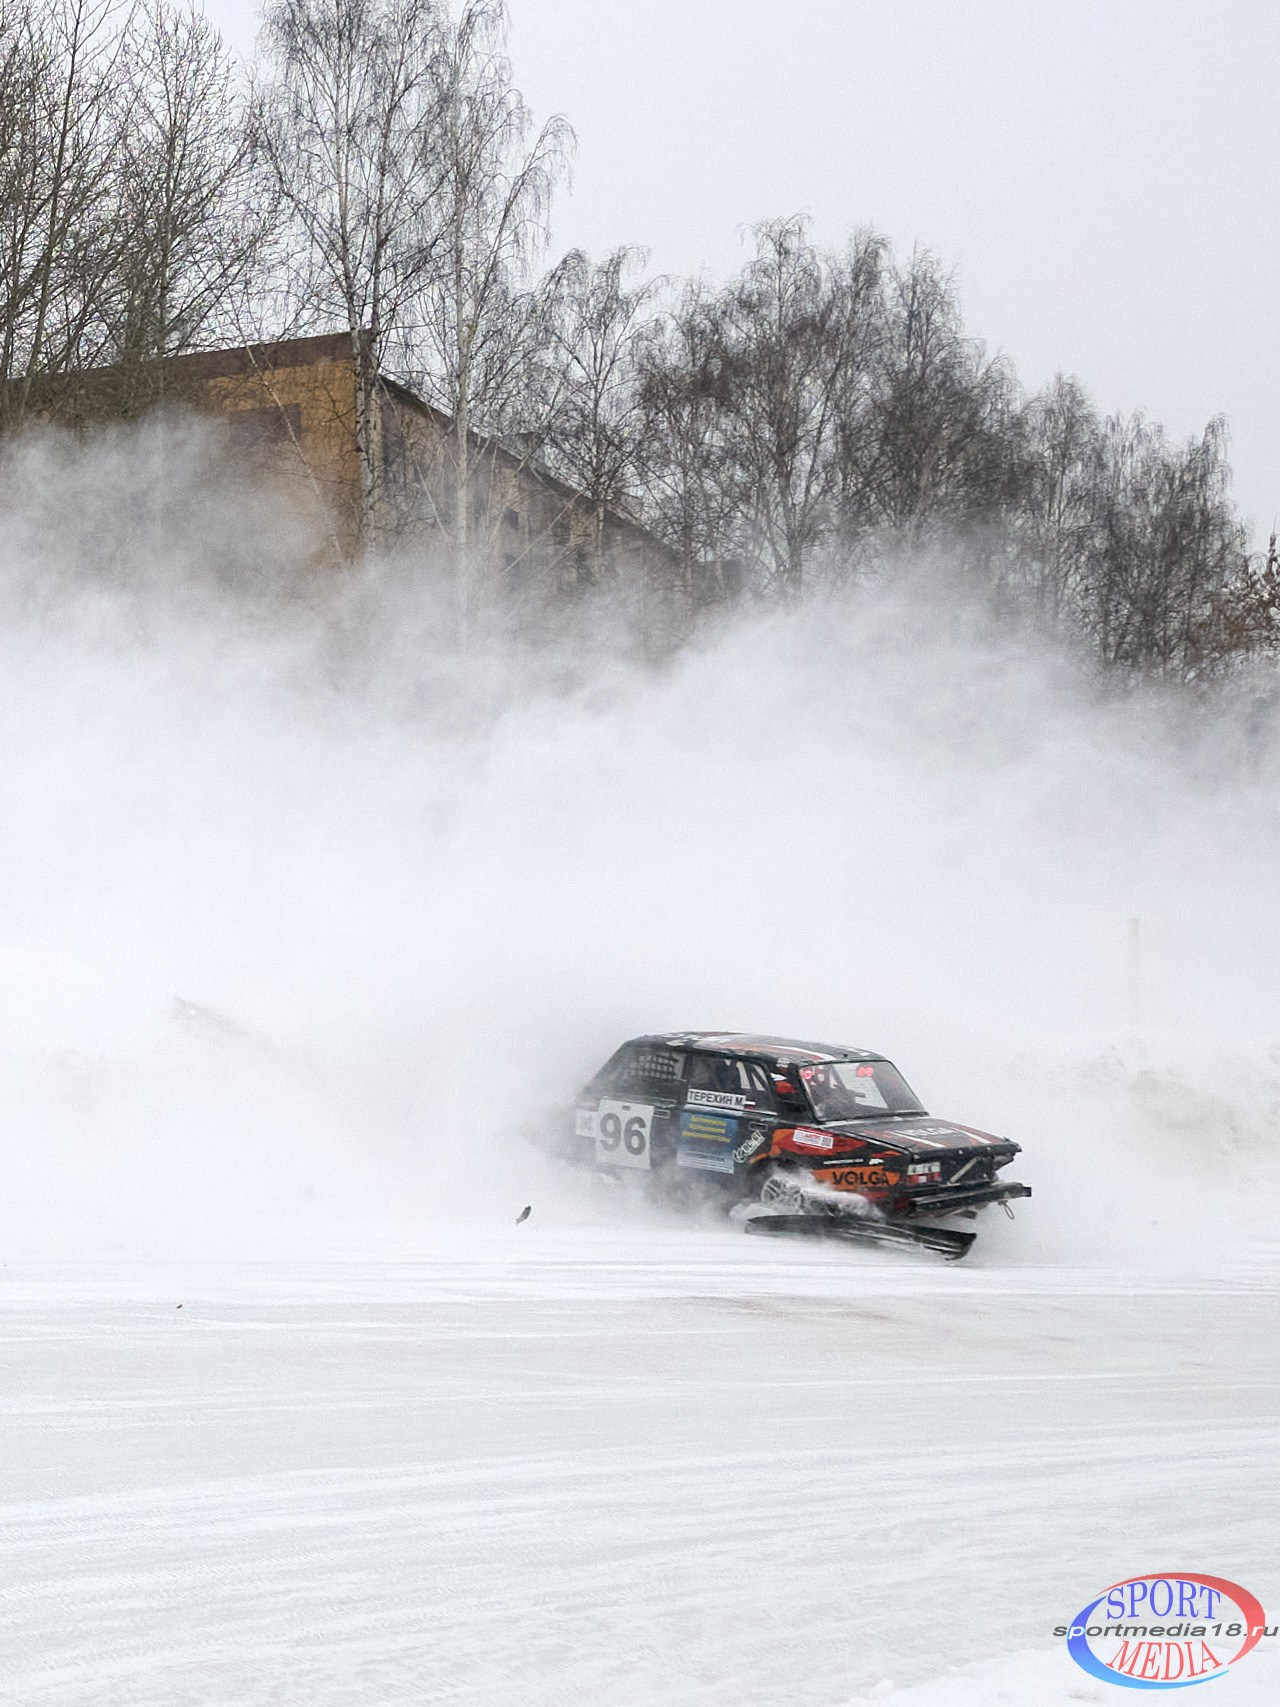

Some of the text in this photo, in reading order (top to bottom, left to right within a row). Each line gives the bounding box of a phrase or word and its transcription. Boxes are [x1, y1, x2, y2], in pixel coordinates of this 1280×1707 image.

[688, 1090, 733, 1105] ТЕРЕХИН
[599, 1112, 647, 1156] 96
[832, 1170, 890, 1186] VOLGA
